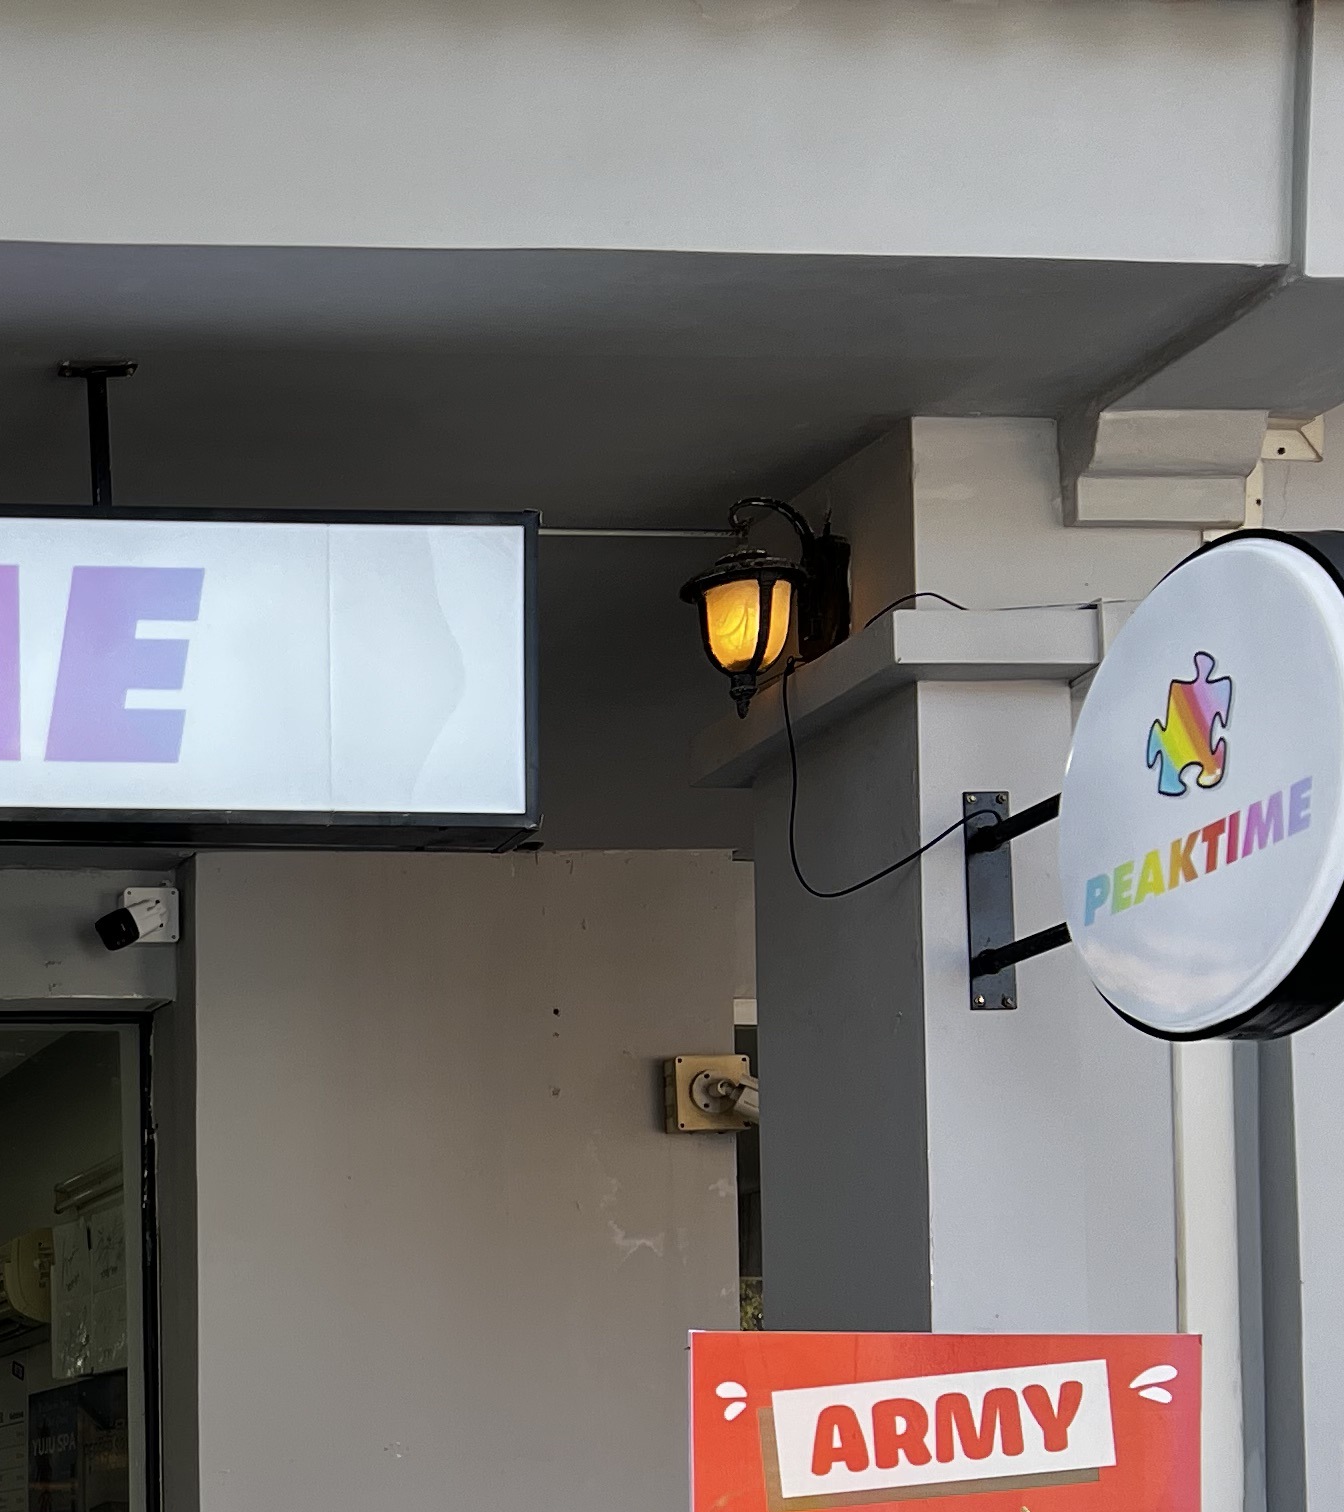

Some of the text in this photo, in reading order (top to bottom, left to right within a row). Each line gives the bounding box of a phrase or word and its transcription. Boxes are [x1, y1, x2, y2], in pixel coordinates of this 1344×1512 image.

[1084, 775, 1313, 926] PEAKTIME
[57, 1433, 77, 1453] SPA
[812, 1380, 1083, 1476] ARMY
